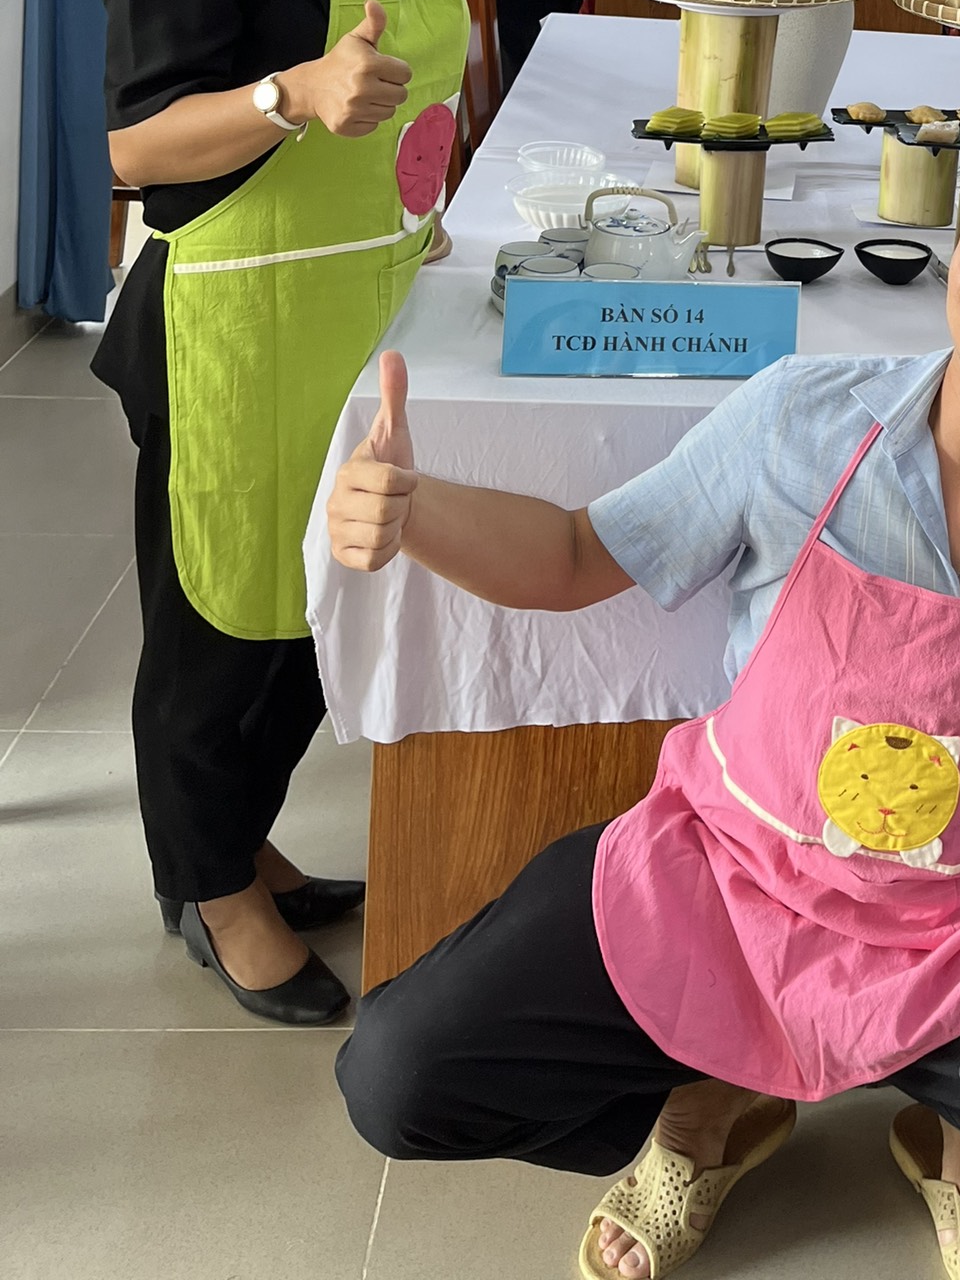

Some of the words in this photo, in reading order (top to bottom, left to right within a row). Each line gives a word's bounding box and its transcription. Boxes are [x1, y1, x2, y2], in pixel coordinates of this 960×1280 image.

[600, 303, 645, 323] BÀN
[685, 308, 705, 324] 14
[552, 335, 597, 351] TCĐ
[602, 331, 666, 352] HÀNH
[671, 332, 748, 353] CHÁNH
